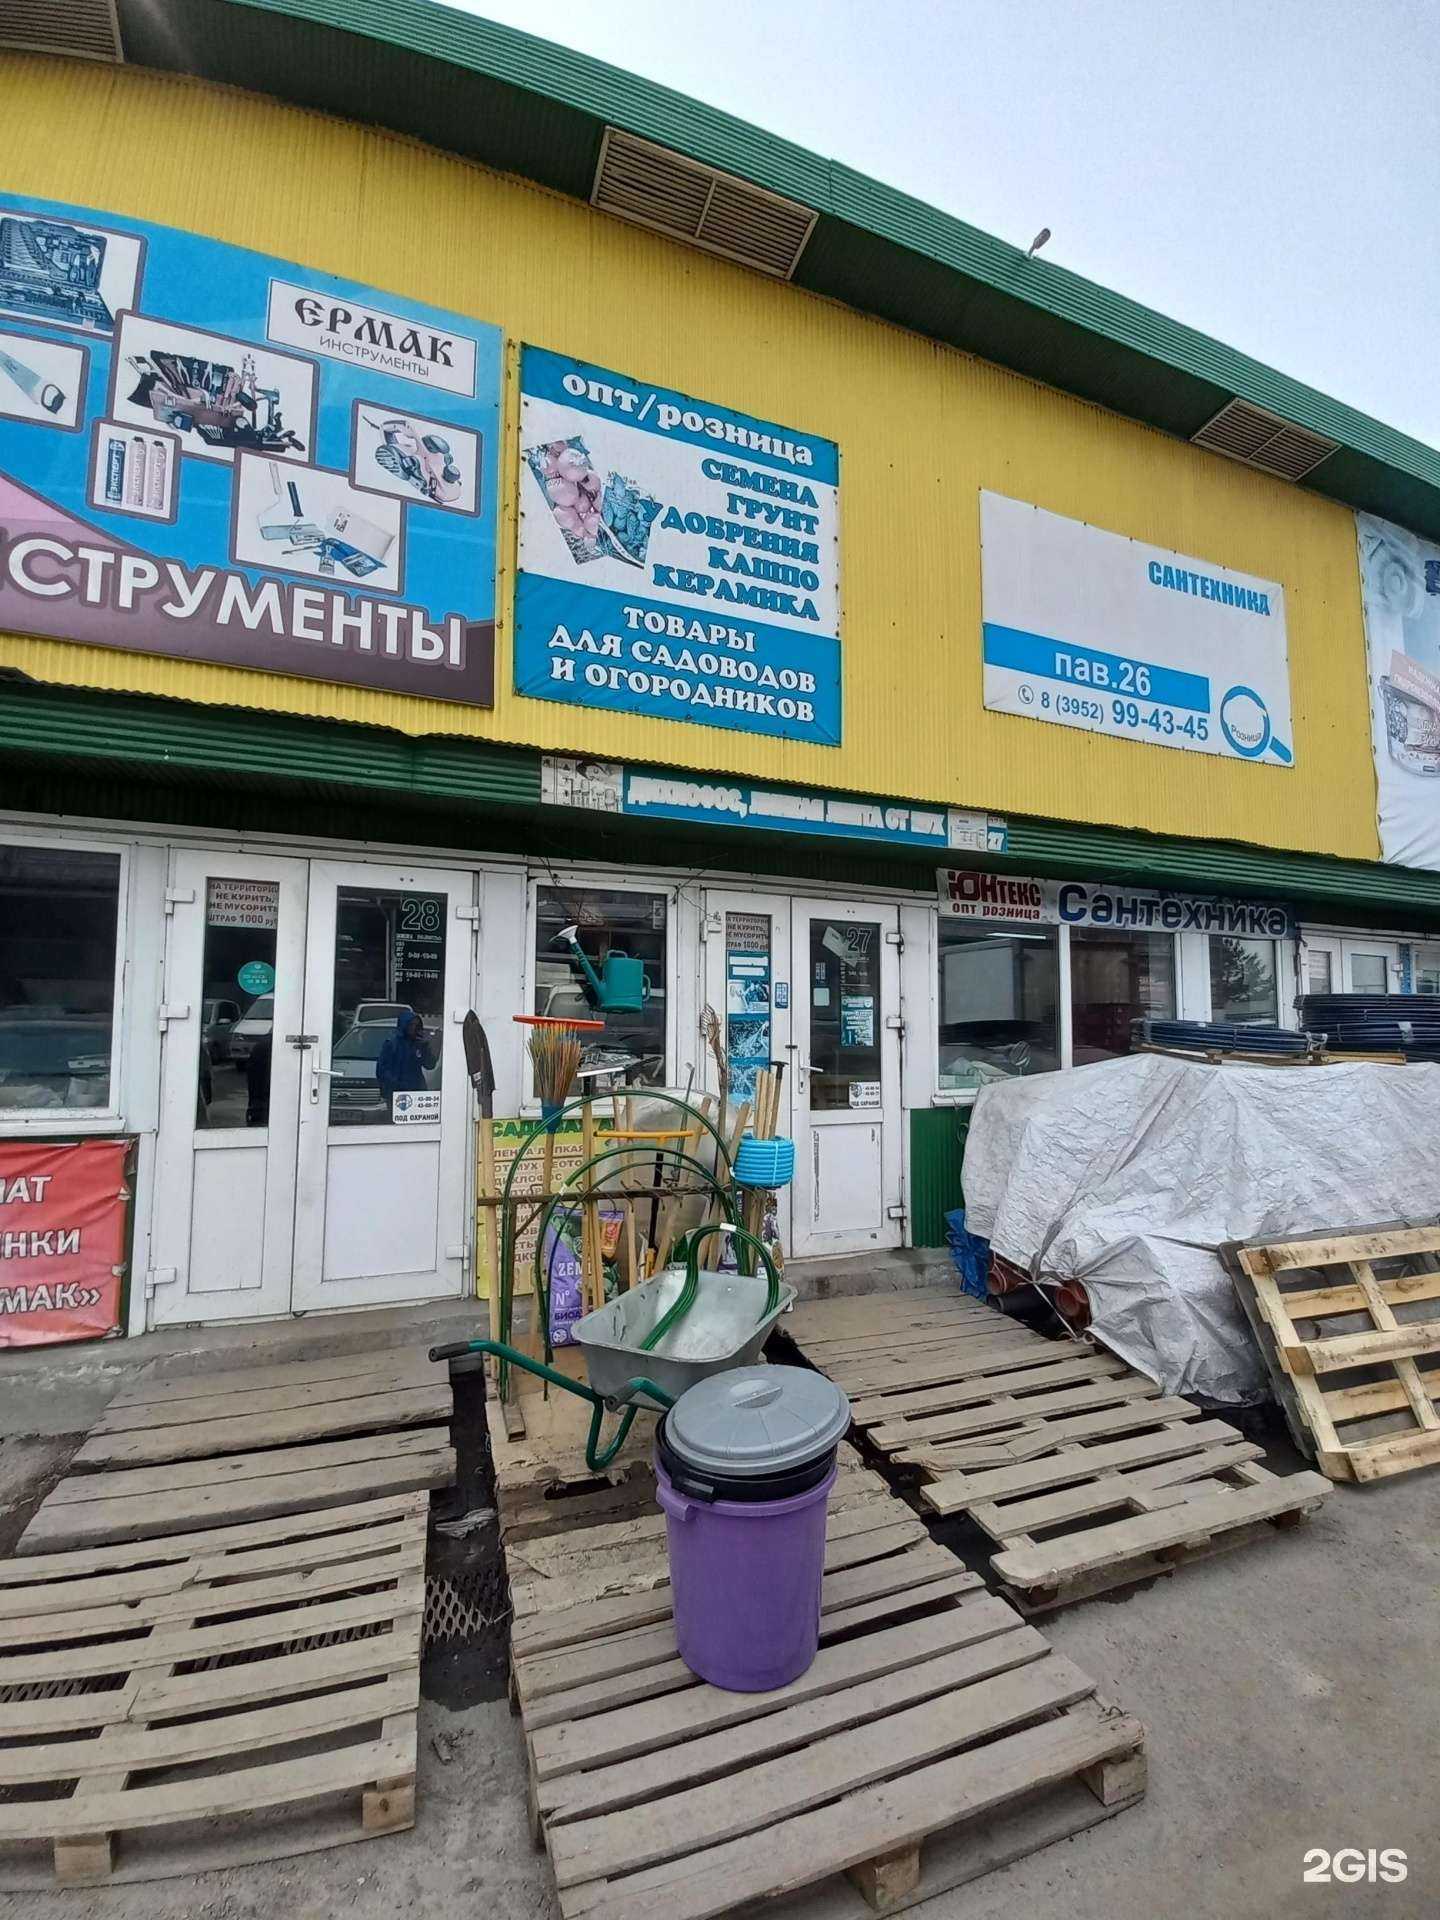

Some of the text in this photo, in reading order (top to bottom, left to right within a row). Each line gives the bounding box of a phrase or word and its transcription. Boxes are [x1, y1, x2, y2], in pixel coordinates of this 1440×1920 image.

[320, 335, 430, 377] ИНСТРУМЕНТЫ
[701, 458, 819, 508] СЕМЕНА
[639, 498, 819, 564] УДОБРЕНИЯ
[727, 492, 819, 535] ГРУНТ
[708, 546, 820, 591] КАШПО
[1148, 560, 1270, 616] САНТЕХНИКА
[652, 564, 820, 621] КЕРАМИКА
[623, 606, 755, 652] ТОВАРЫ
[548, 624, 816, 693] ДЛЯ САДОВОДОВ
[1055, 652, 1152, 696] пав.26
[550, 656, 816, 722] И ОГОРОДНИКОВ
[1040, 691, 1209, 741] 8 (3952) 99-43-45
[207, 914, 238, 922] ШТРАФ
[240, 914, 263, 924] 1000
[208, 902, 223, 910] НЕ
[401, 898, 440, 931] 28
[952, 903, 1040, 920] опт розница
[1058, 884, 1287, 936] Сантехника
[846, 926, 872, 954] 27
[494, 1144, 584, 1157] ЛЕНА ЛПКАЯ
